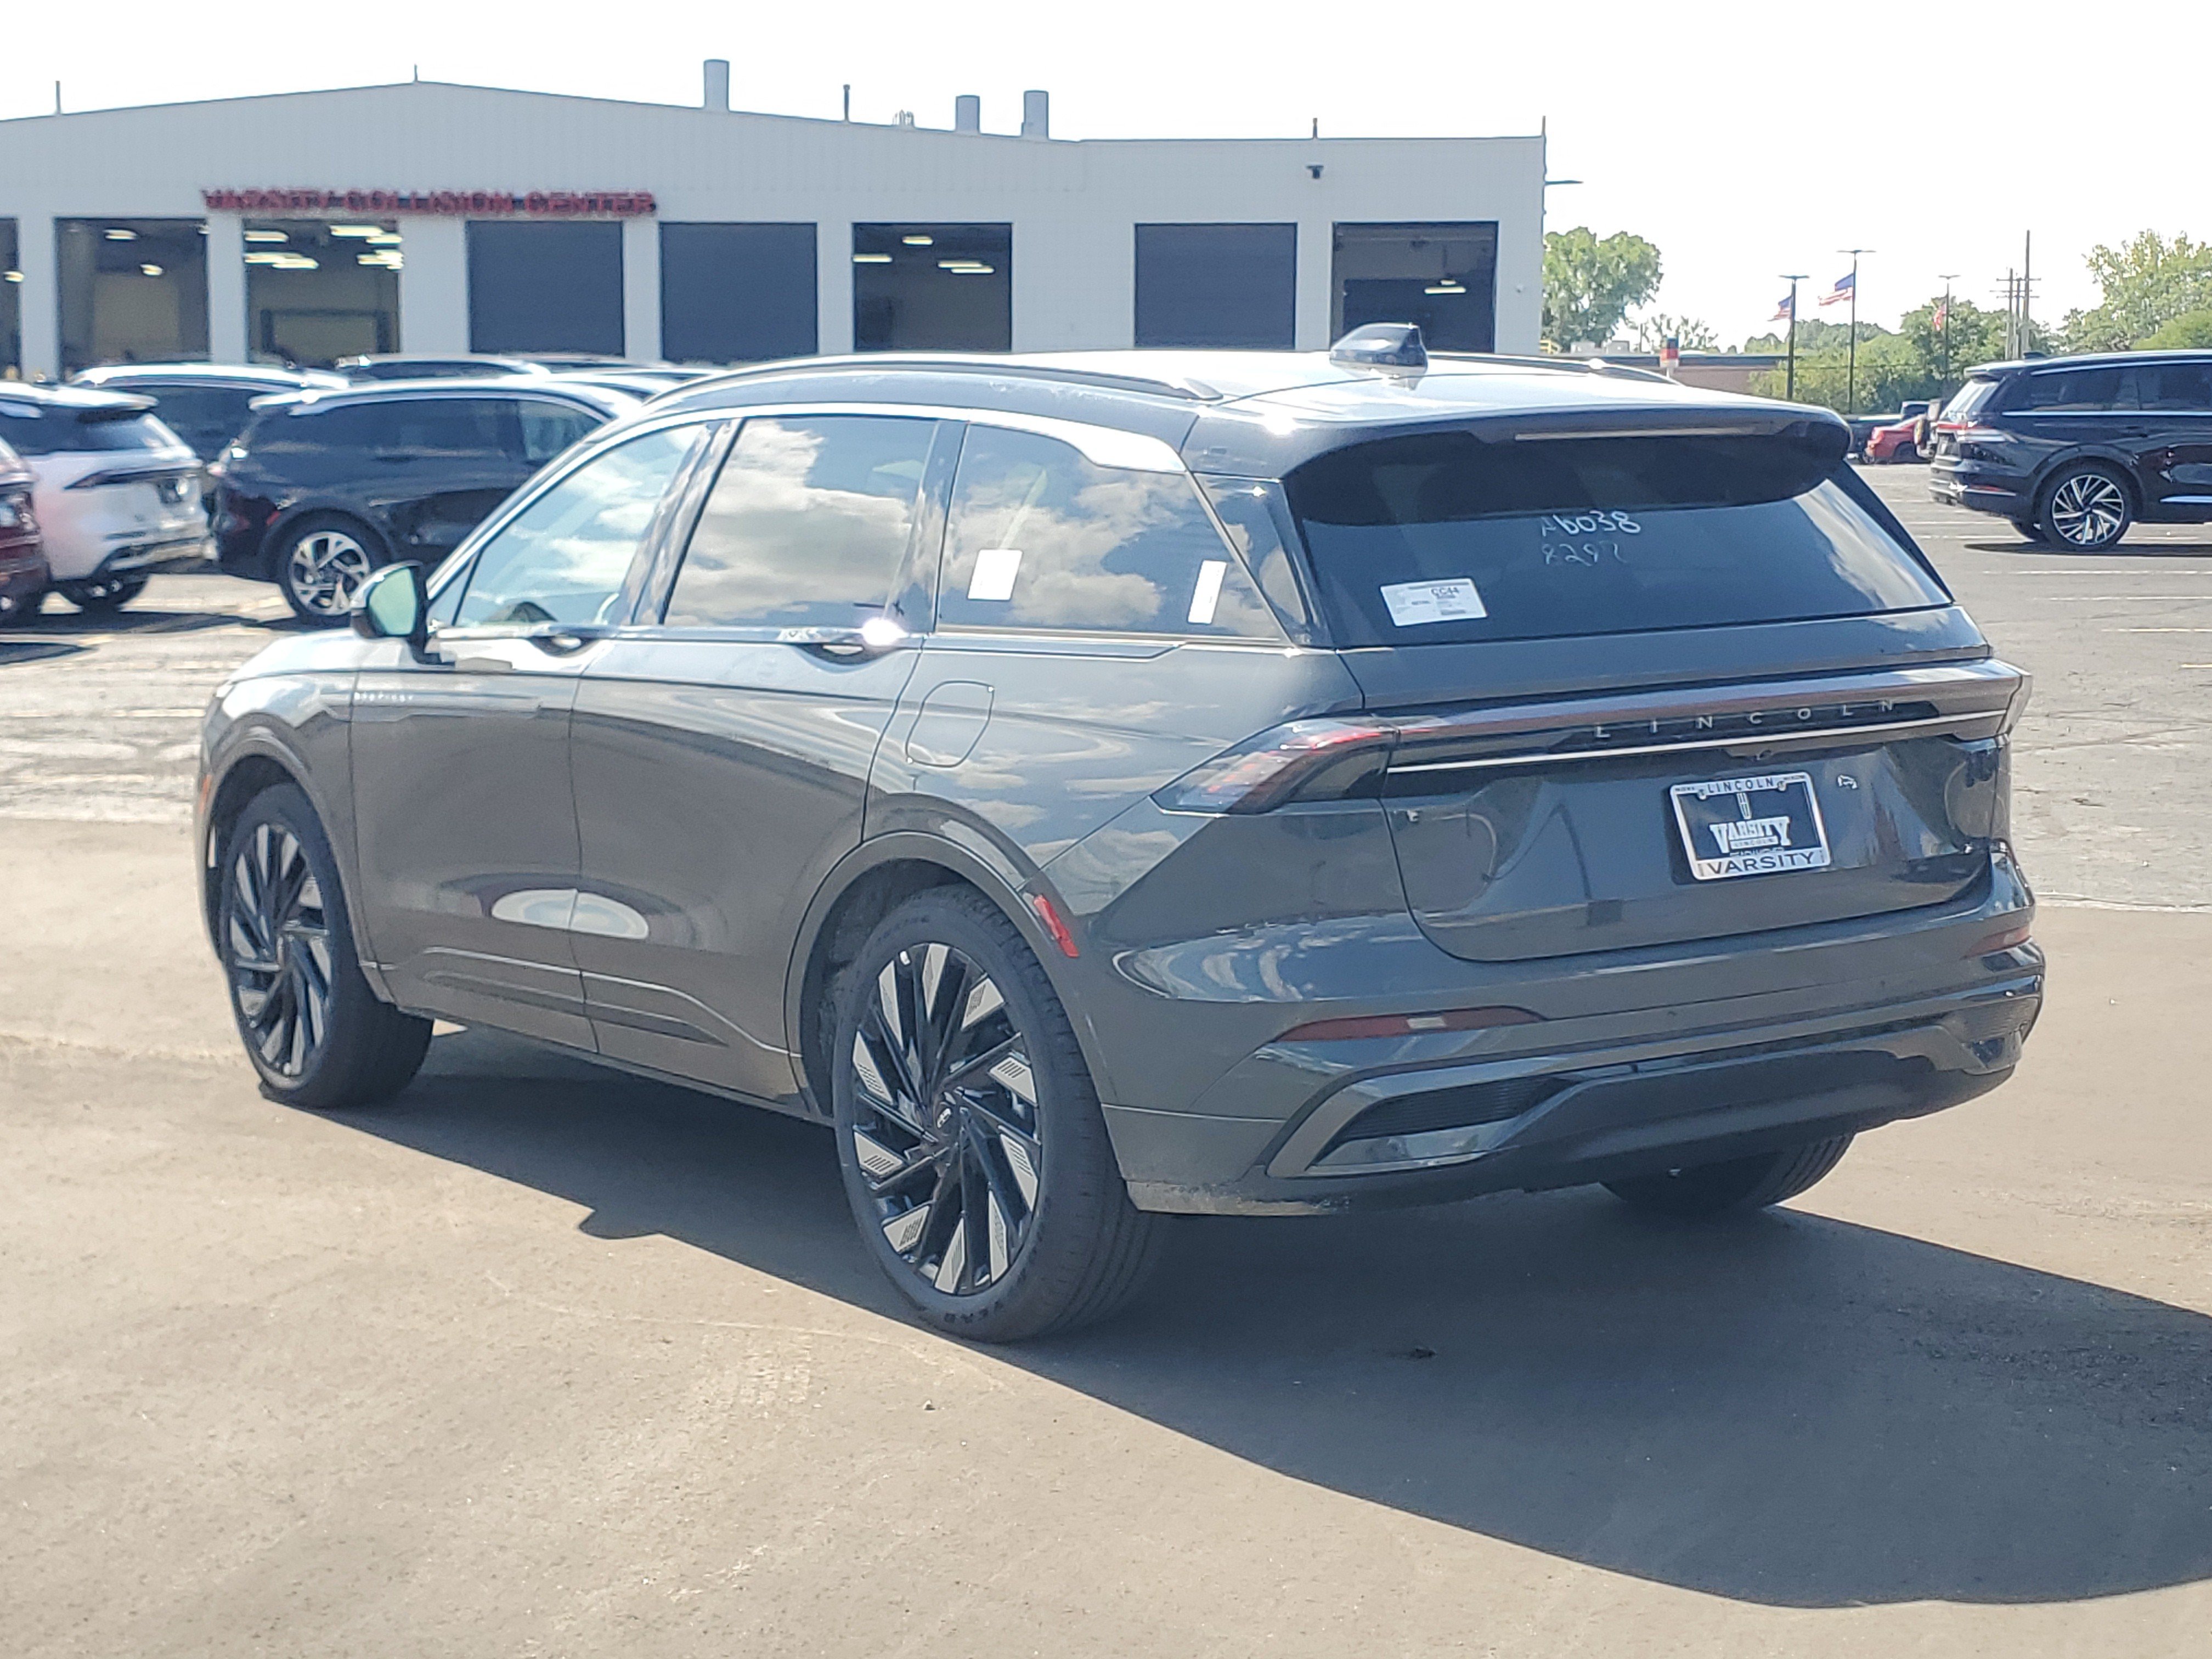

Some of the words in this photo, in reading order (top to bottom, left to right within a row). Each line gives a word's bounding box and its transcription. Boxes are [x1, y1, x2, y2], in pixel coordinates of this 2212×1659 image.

[347, 190, 514, 213] COLLISION
[524, 191, 656, 215] CENTER
[1595, 699, 1893, 738] LINCOLN
[1707, 777, 1774, 794] LINCOLN
[1709, 816, 1792, 854] VARSITY
[1707, 851, 1814, 874] VARSITY
